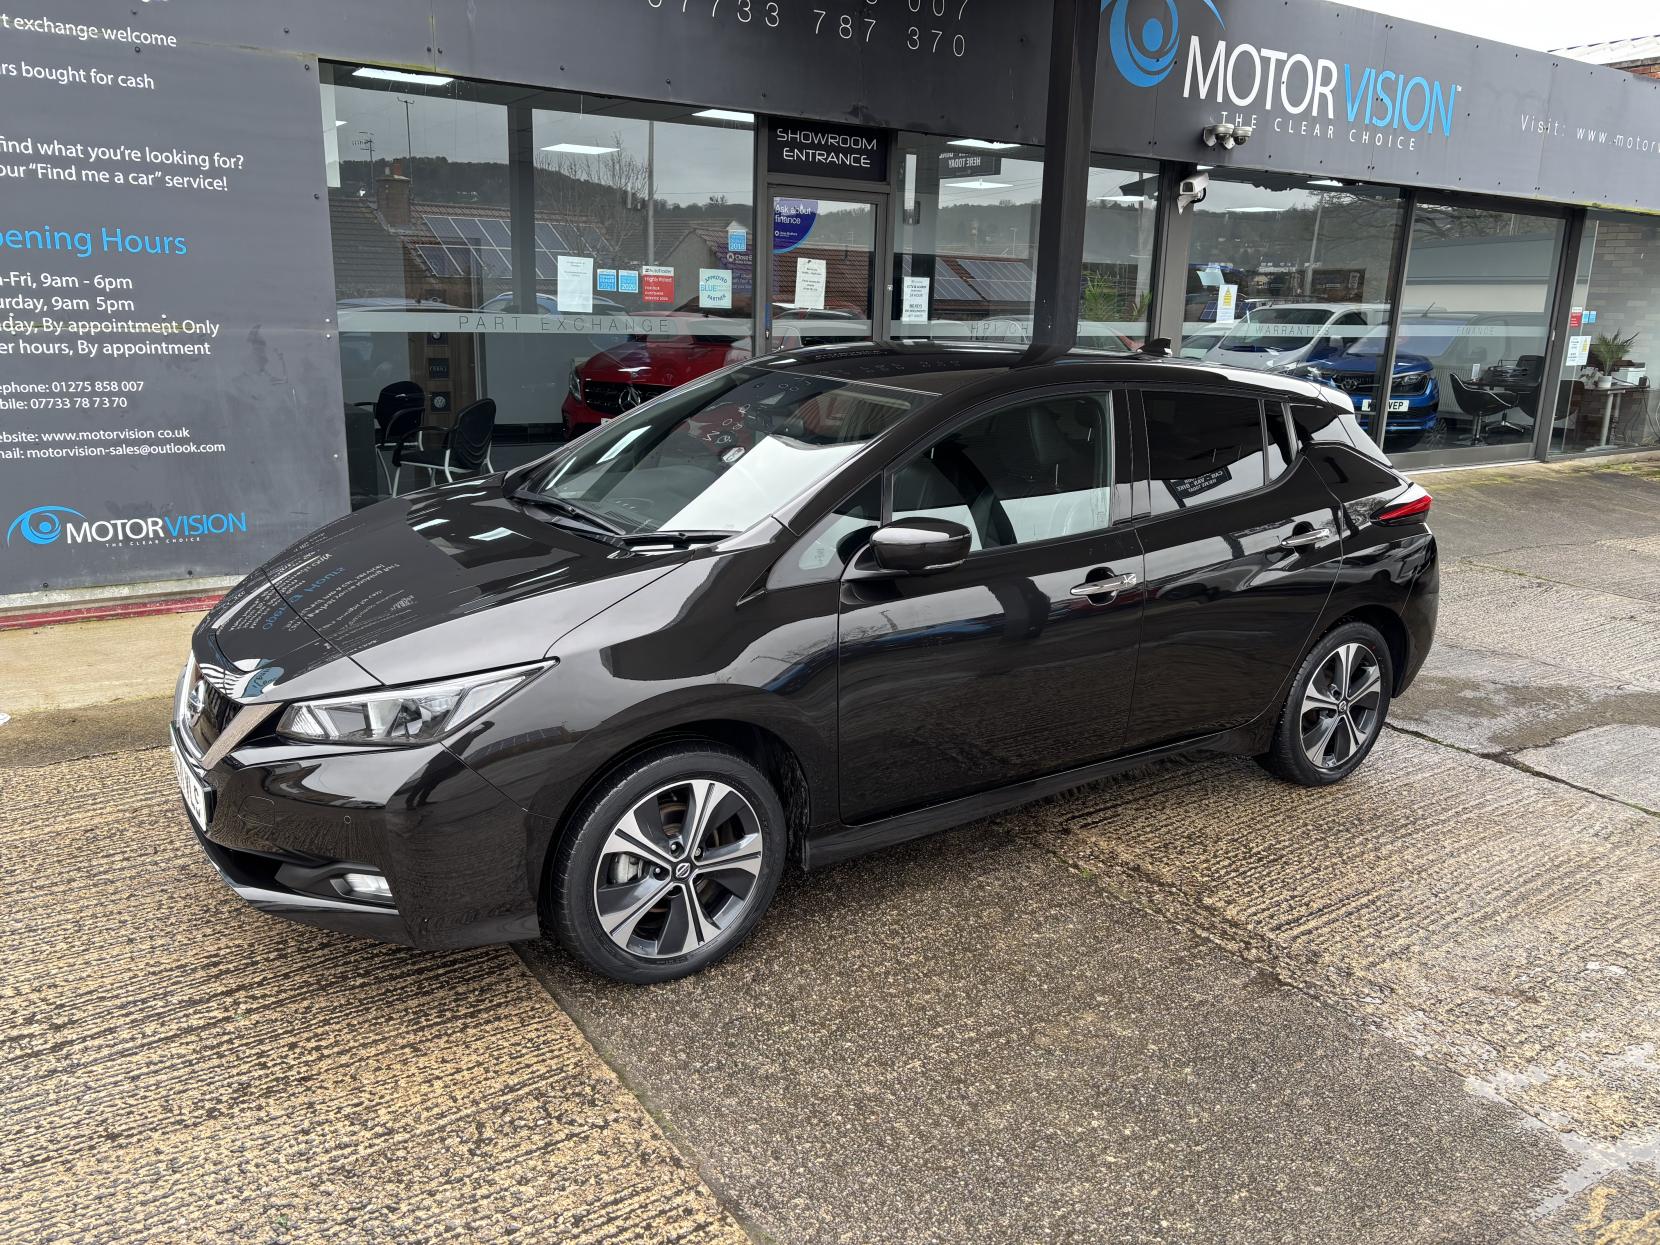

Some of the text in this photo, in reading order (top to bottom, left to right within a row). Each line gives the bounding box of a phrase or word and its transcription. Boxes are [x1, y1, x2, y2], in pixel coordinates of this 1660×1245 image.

[14, 17, 98, 40] exchange
[102, 27, 176, 47] welcome
[813, 9, 876, 42] 787
[907, 26, 965, 57] 370
[0, 61, 154, 89] rs bought for cash
[1183, 35, 1457, 137] MOTORVISION
[1221, 112, 1416, 151] THE CLEAR CHOICE
[1521, 114, 1566, 137] Visit:
[776, 128, 877, 150] SHOWROOM
[37, 140, 84, 157] what
[146, 147, 209, 170] looking
[214, 153, 243, 169] for?
[783, 148, 871, 167] ENTRANCE
[82, 171, 109, 182] me
[115, 172, 123, 183] a
[166, 175, 227, 191] service!
[774, 204, 811, 215] Ask about
[775, 214, 801, 225] finance
[0, 226, 186, 257] ening Hours
[41, 273, 78, 287] 9am
[94, 275, 132, 291] 6pm
[52, 297, 89, 310] 9am
[97, 297, 134, 313] 5pm
[0, 317, 220, 338] day, By appointment Only
[459, 315, 670, 333] PART EXCHANGE
[20, 339, 73, 355] hours,
[78, 340, 98, 357] By
[103, 341, 210, 357] appointment
[0, 382, 143, 395] phone: 01275 858 007
[31, 398, 70, 408] 07733
[74, 398, 89, 408] 78
[27, 442, 225, 457] motorvision-sales@outlook.com
[66, 512, 247, 544] MOTORVISION
